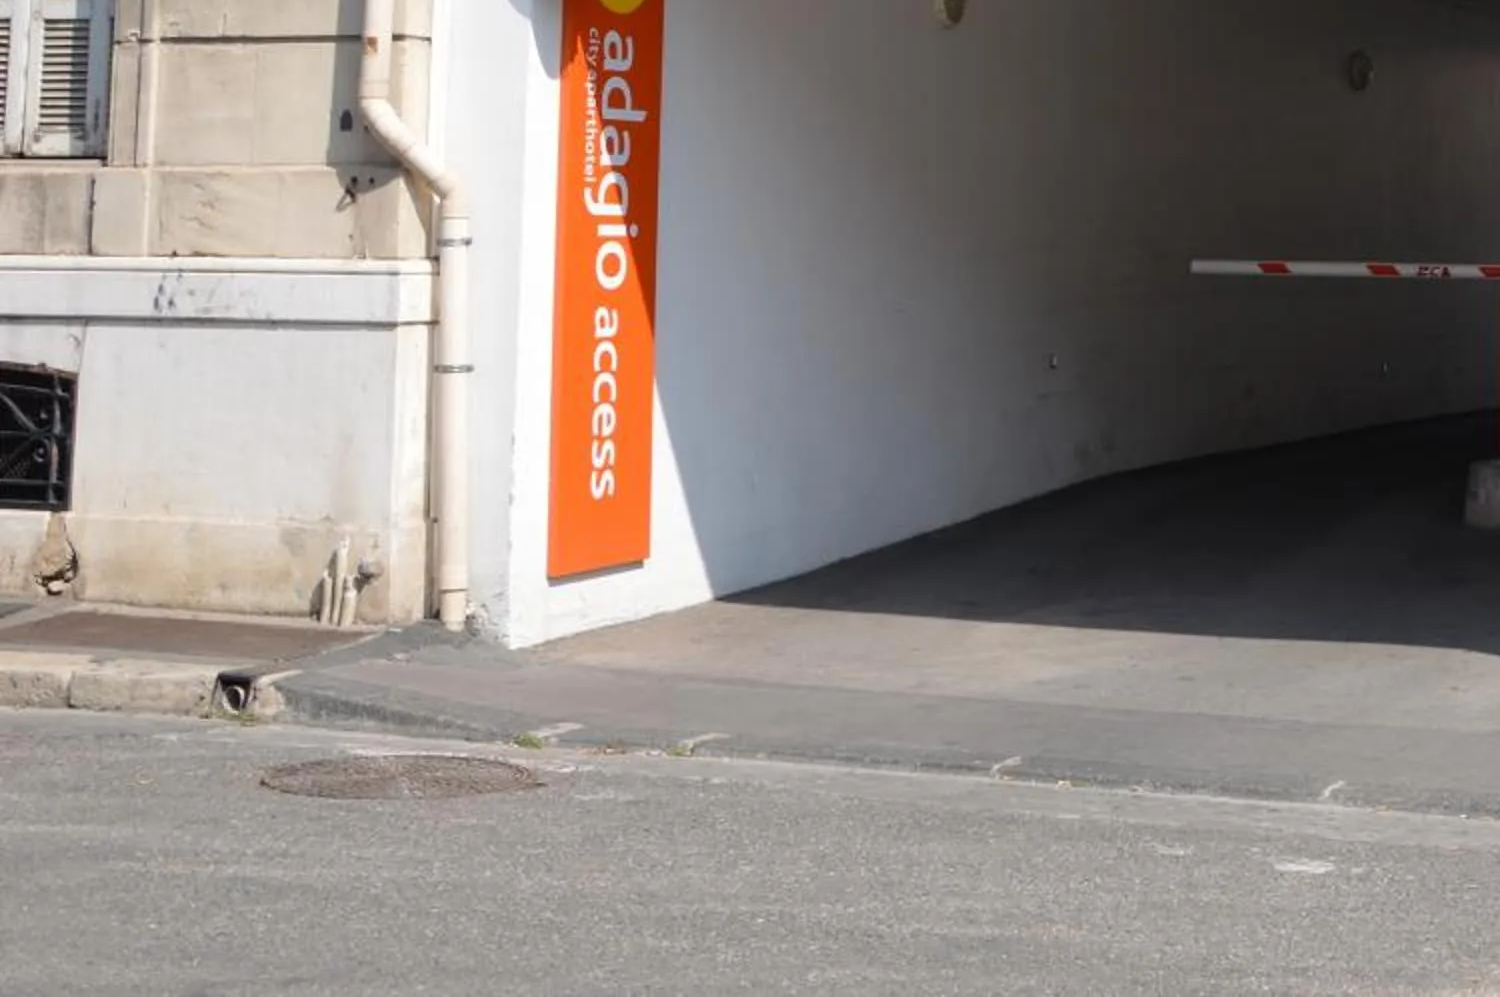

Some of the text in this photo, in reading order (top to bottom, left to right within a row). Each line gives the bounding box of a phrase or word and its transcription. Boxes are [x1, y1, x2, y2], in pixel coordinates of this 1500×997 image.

[584, 27, 600, 182] city aparthotel
[584, 29, 648, 500] adagio access
